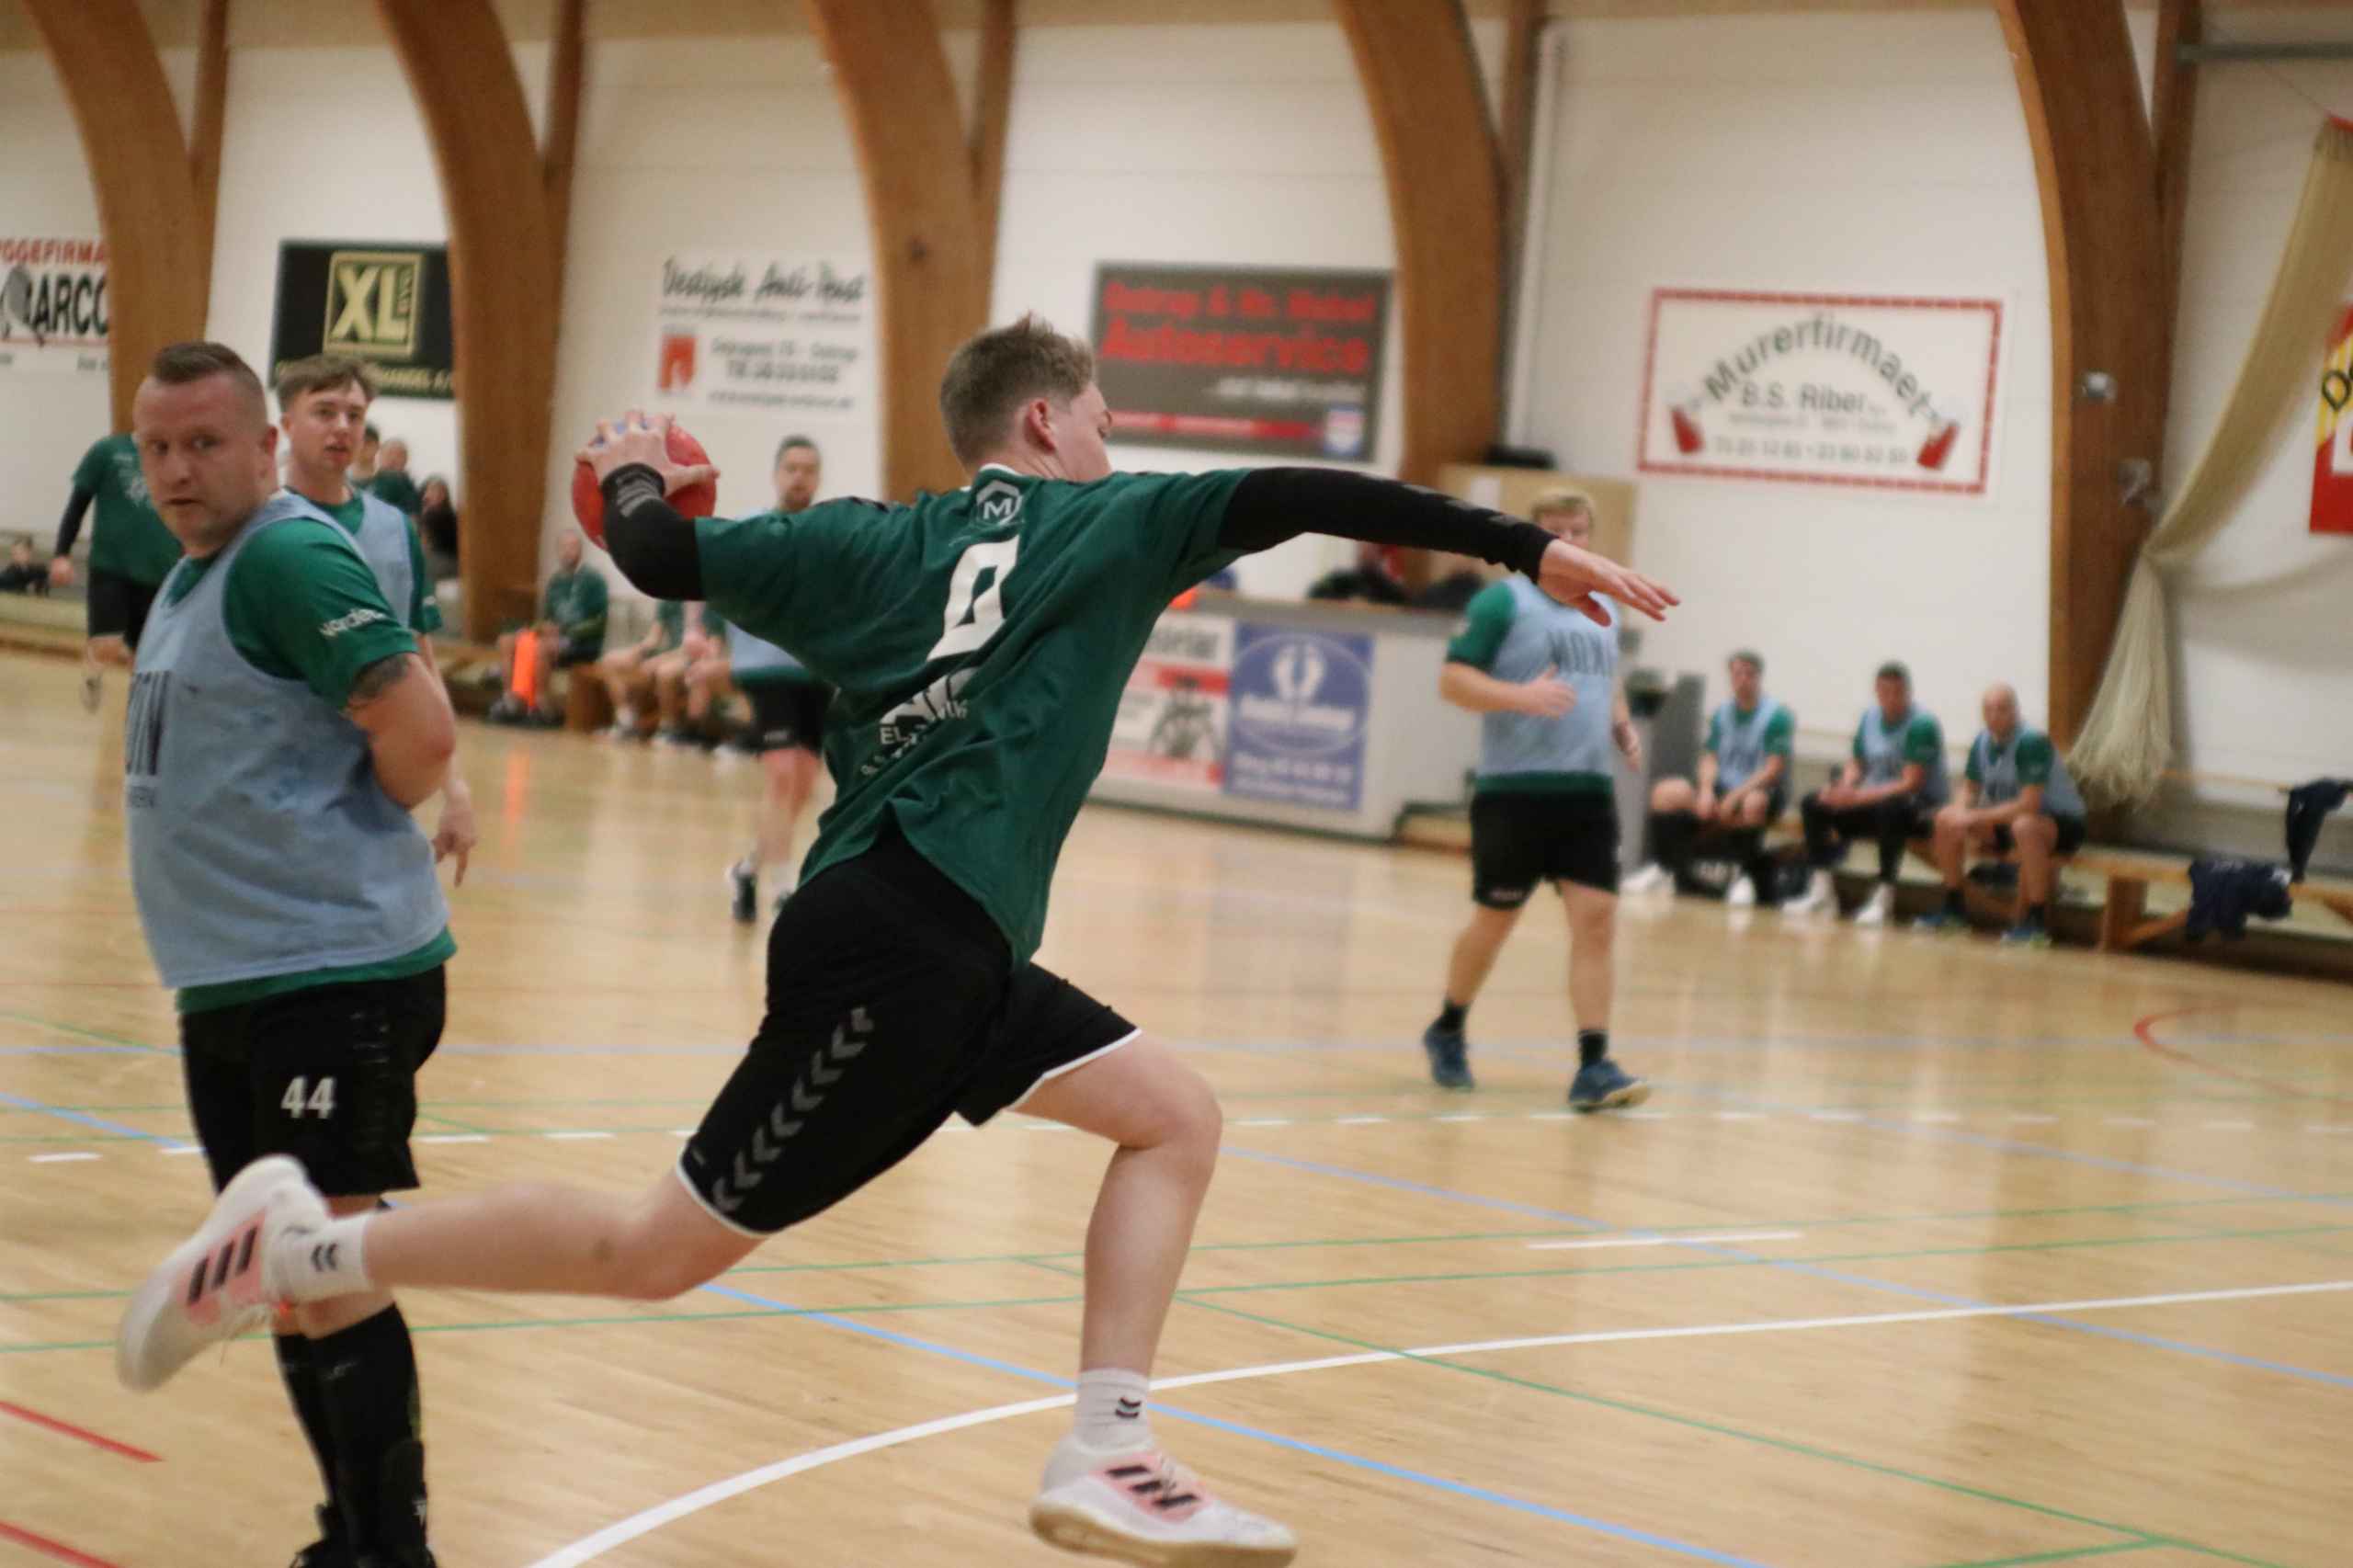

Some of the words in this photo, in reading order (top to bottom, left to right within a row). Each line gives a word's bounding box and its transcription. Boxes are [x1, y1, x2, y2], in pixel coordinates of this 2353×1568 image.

[329, 263, 408, 340] XL
[1102, 316, 1368, 374] Autoservice
[1703, 313, 1933, 418] Murerfirmaet
[280, 1074, 336, 1119] 44
